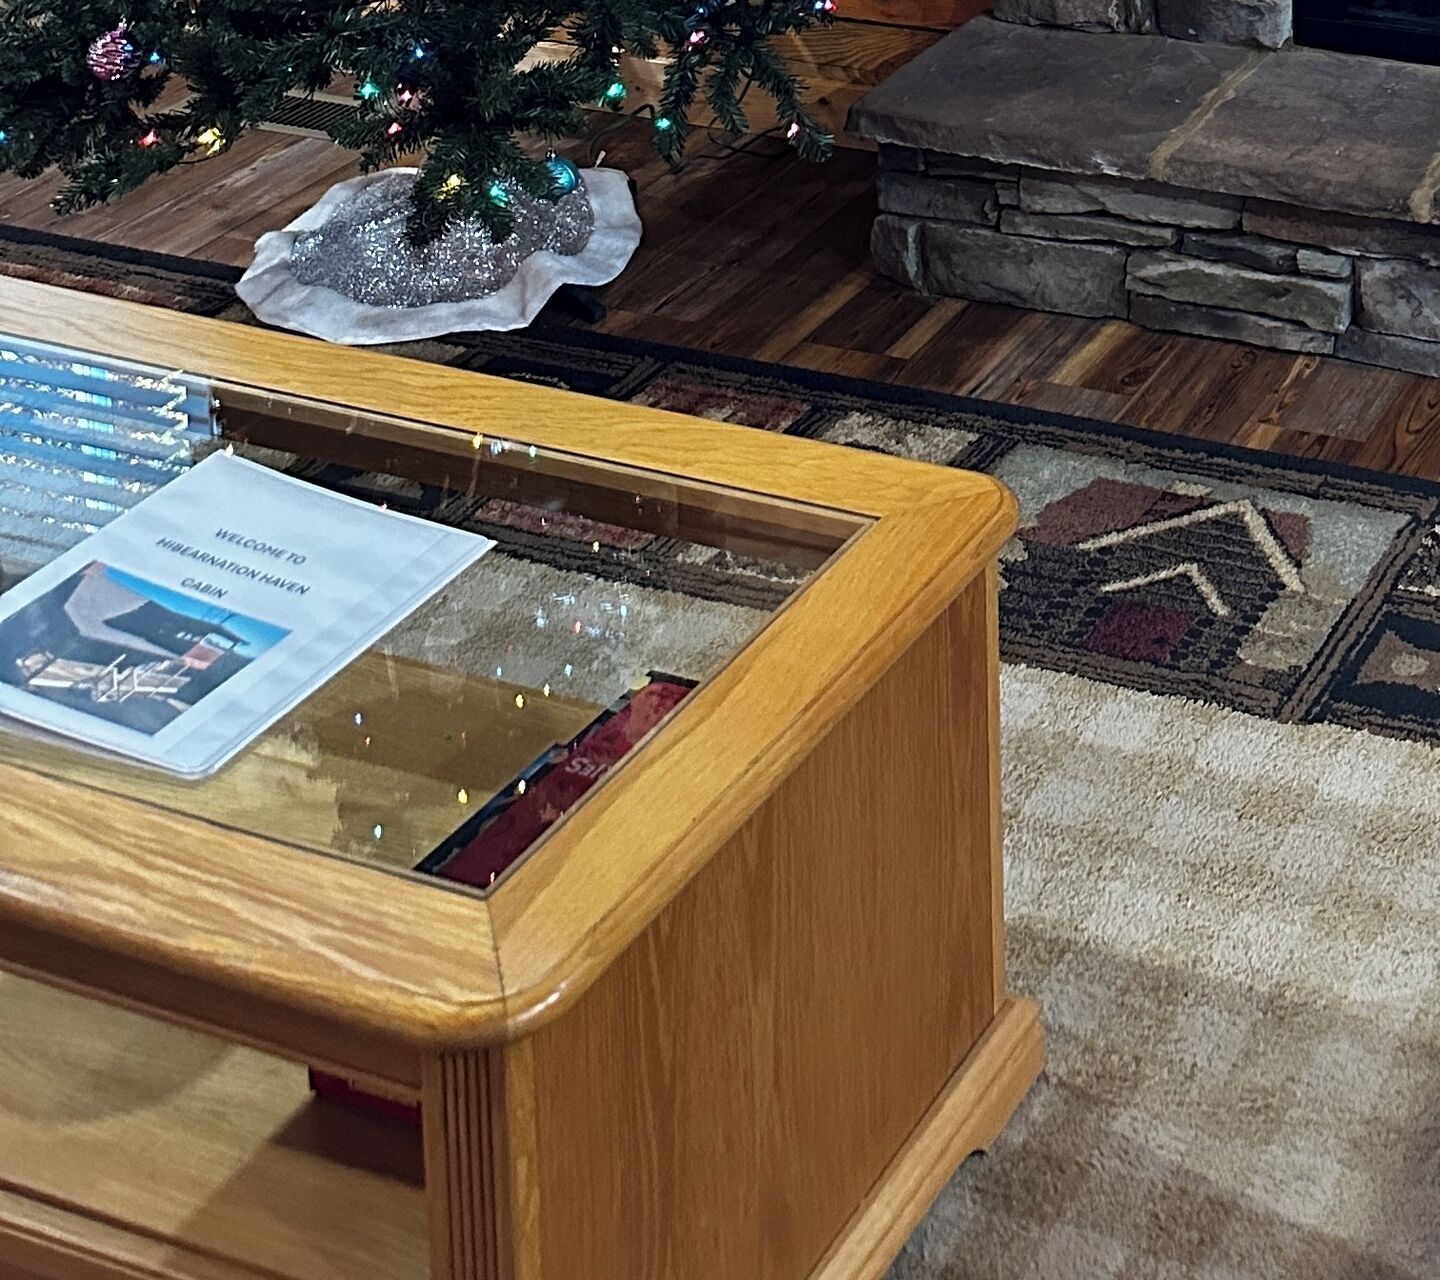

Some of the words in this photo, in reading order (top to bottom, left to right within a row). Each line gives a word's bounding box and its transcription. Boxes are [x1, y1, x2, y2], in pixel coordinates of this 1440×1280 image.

[215, 527, 288, 559] WELCOME
[285, 552, 307, 566] TO
[155, 537, 262, 580] HIBEARNATION
[258, 572, 311, 596] HAVEN
[180, 577, 229, 600] CABIN
